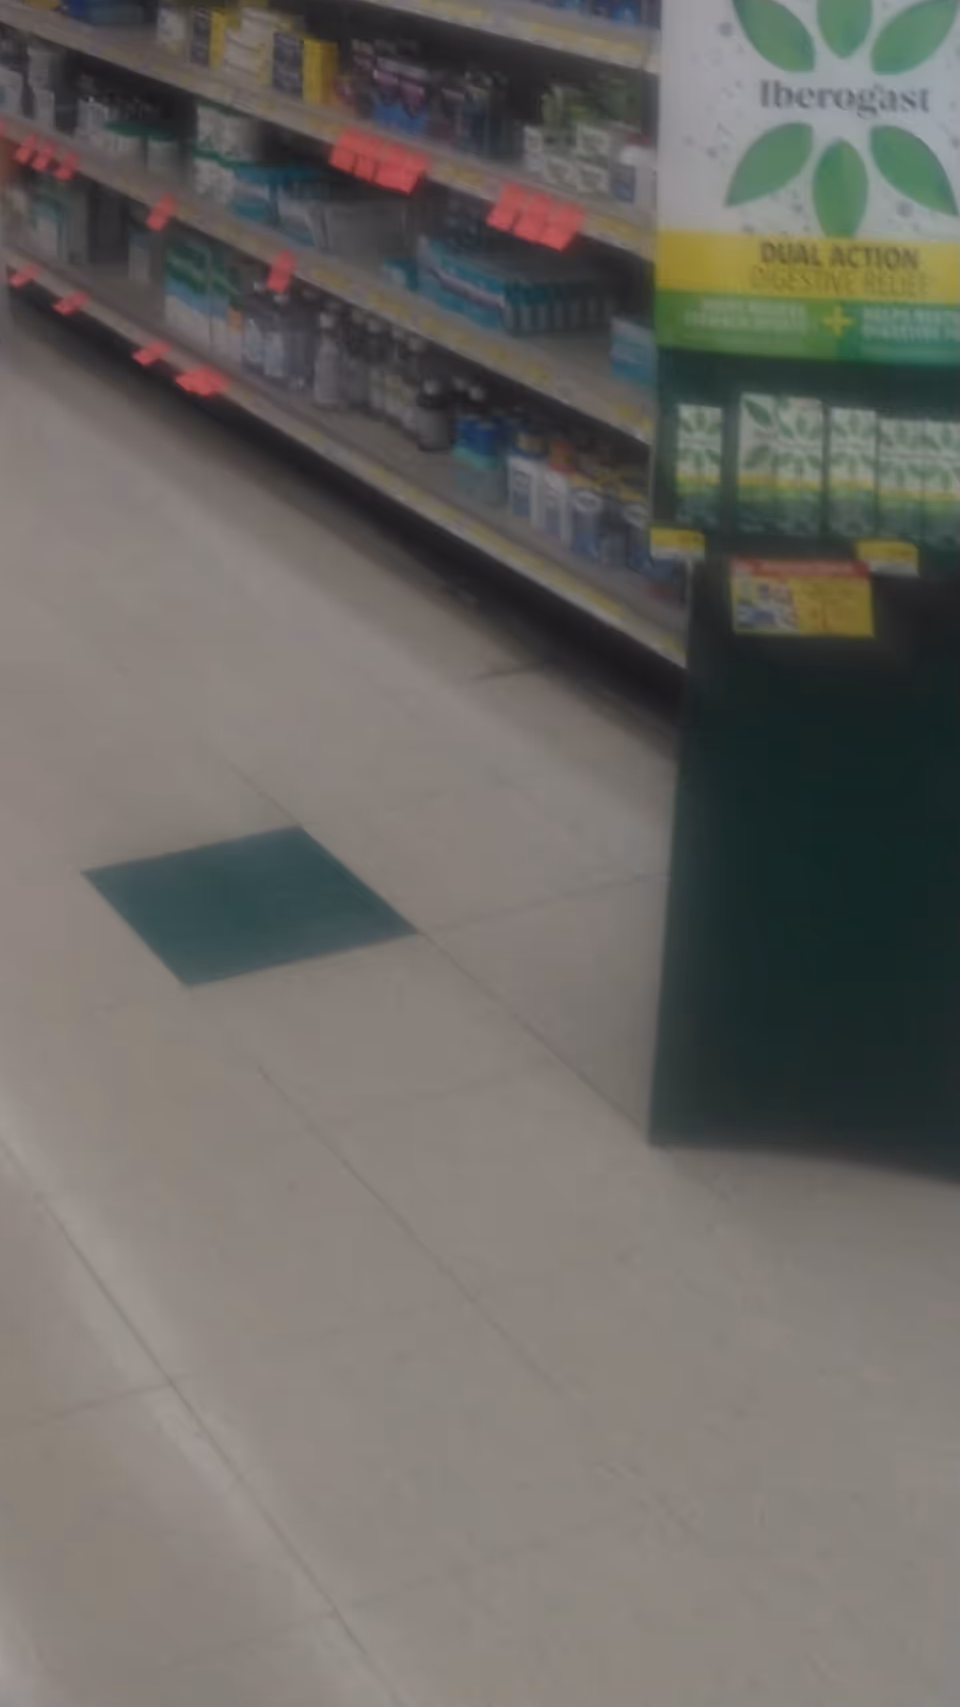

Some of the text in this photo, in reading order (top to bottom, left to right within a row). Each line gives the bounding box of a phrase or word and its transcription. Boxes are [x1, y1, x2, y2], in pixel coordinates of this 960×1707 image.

[758, 79, 930, 119] Iberogast
[760, 241, 920, 269] DUAL ACTION
